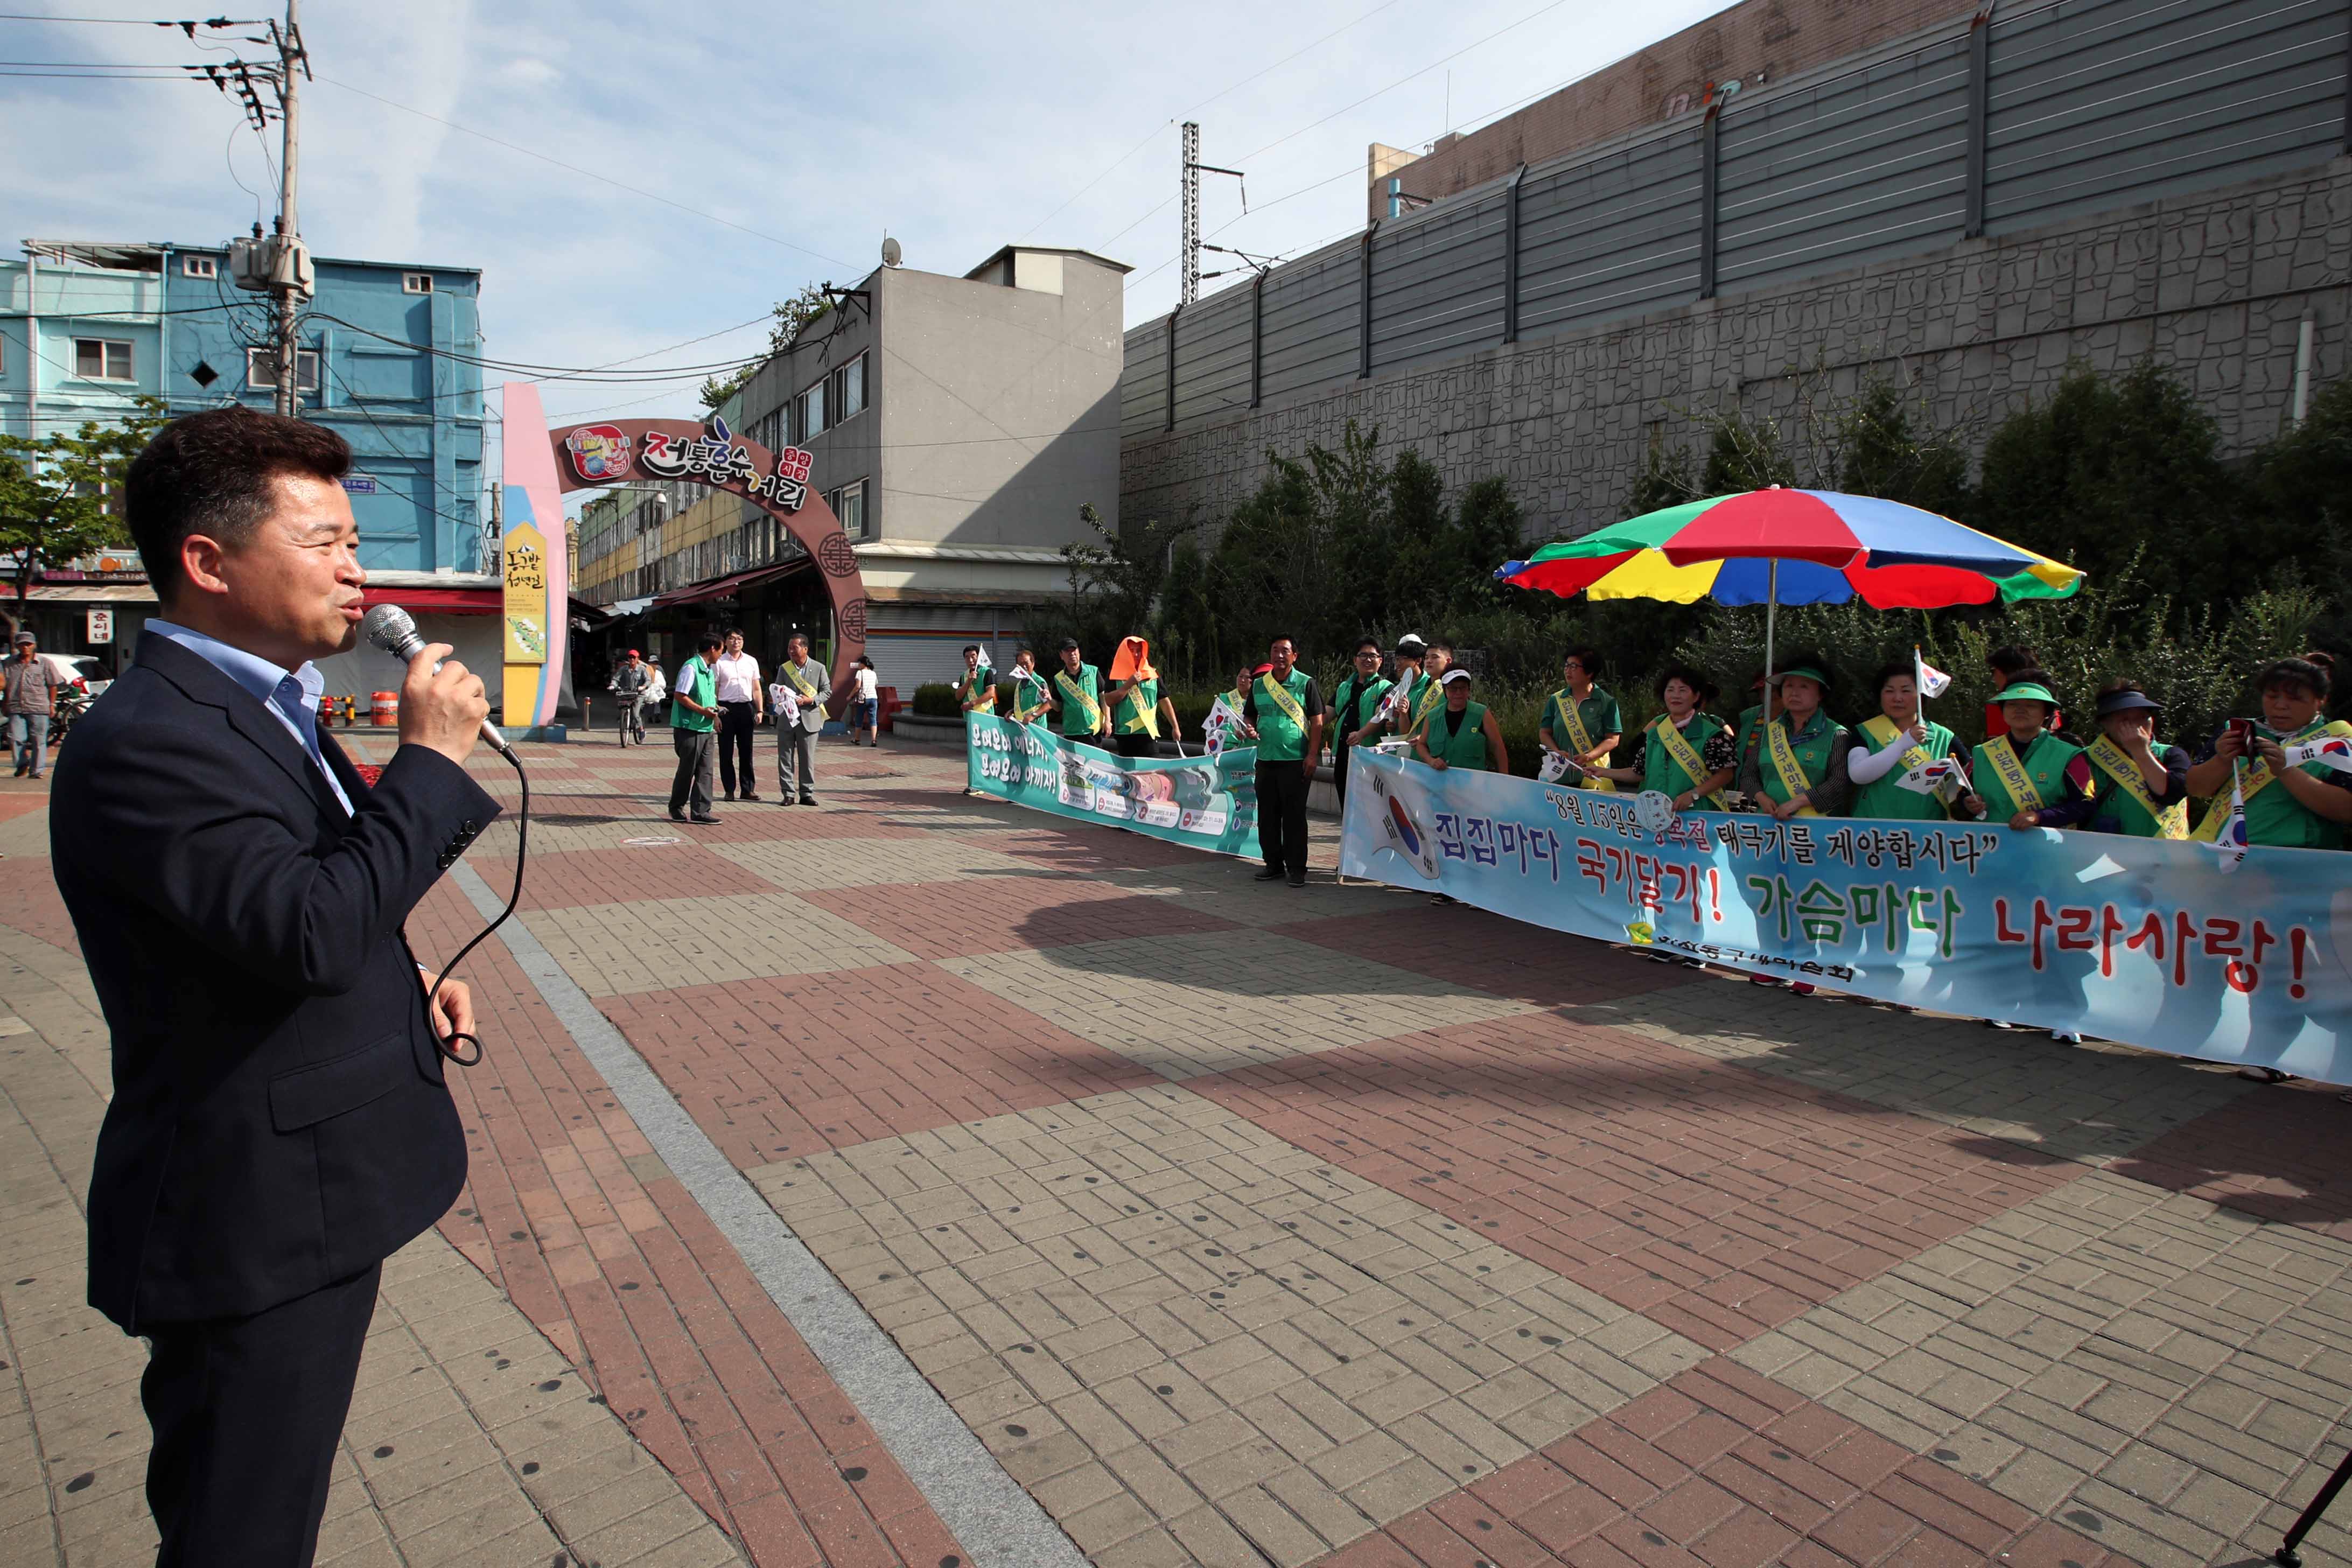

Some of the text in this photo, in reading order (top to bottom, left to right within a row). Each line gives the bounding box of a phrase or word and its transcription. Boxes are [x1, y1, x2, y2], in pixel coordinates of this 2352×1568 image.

[785, 448, 810, 466] 중앙
[782, 464, 808, 480] 시장
[507, 550, 541, 571] 동구밭
[507, 572, 543, 589] 청년길
[1025, 766, 1056, 794] 아끼자!
[1588, 801, 1642, 838] 15일은
[1718, 823, 1816, 864] 태극기를
[1436, 814, 2307, 999] 집집마다 국기달기! 가슴마다 나라사랑!
